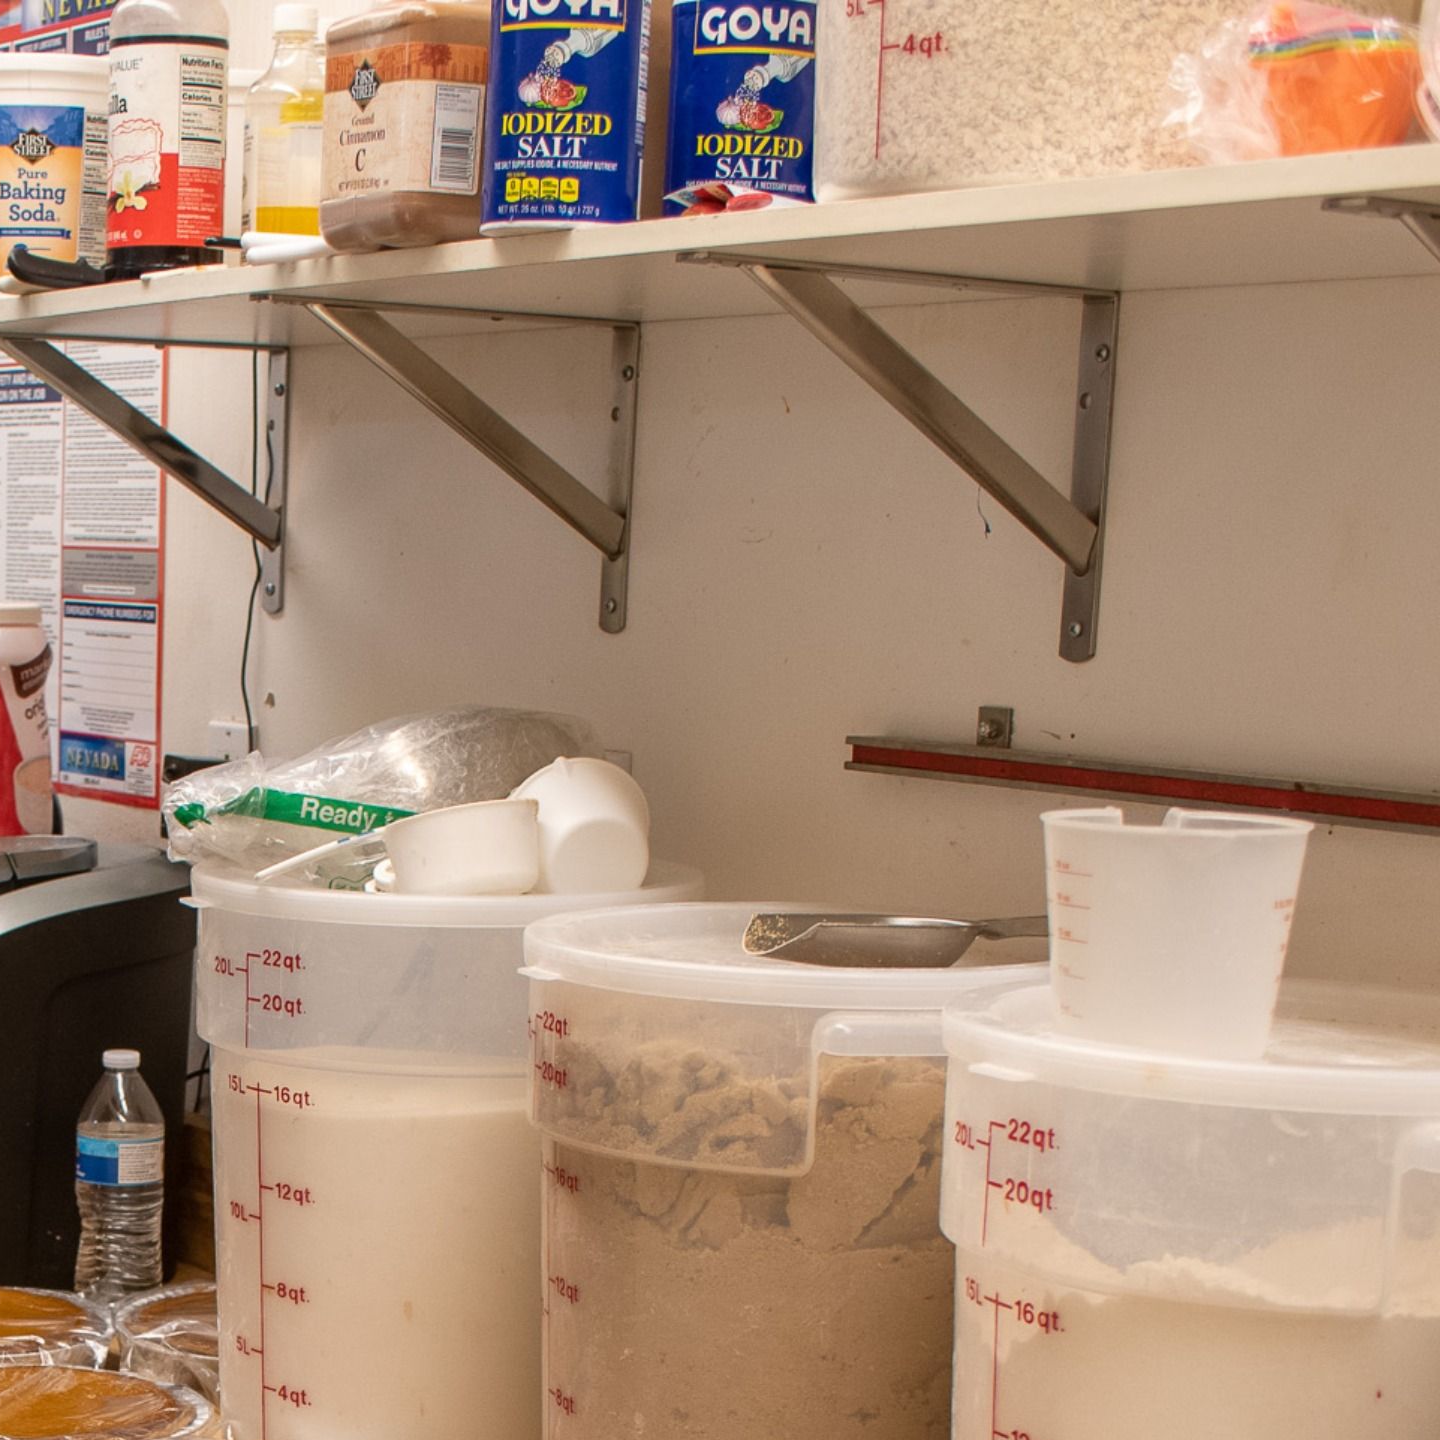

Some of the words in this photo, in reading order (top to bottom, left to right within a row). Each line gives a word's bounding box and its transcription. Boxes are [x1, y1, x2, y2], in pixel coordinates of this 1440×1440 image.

[701, 5, 810, 45] GOYA
[355, 69, 377, 86] FIRST
[351, 82, 377, 100] STREET
[501, 112, 612, 136] IODIZED
[18, 132, 48, 146] FIRST
[339, 127, 386, 146] Cinnamon
[695, 134, 804, 158] IODIZED
[13, 144, 53, 157] STREET
[517, 136, 587, 159] SALT
[354, 148, 366, 172] C
[715, 158, 783, 180] SALT
[17, 168, 48, 179] Pure
[0, 181, 66, 205] Baking
[9, 203, 56, 222] Soda
[67, 748, 120, 774] NEVADA
[300, 797, 378, 832] Ready
[215, 956, 234, 976] 20L
[228, 1074, 246, 1095] 15L
[954, 1121, 975, 1150] 20L
[230, 1201, 248, 1222] 10L
[965, 1276, 983, 1306] 15L
[236, 1336, 250, 1355] 5L
